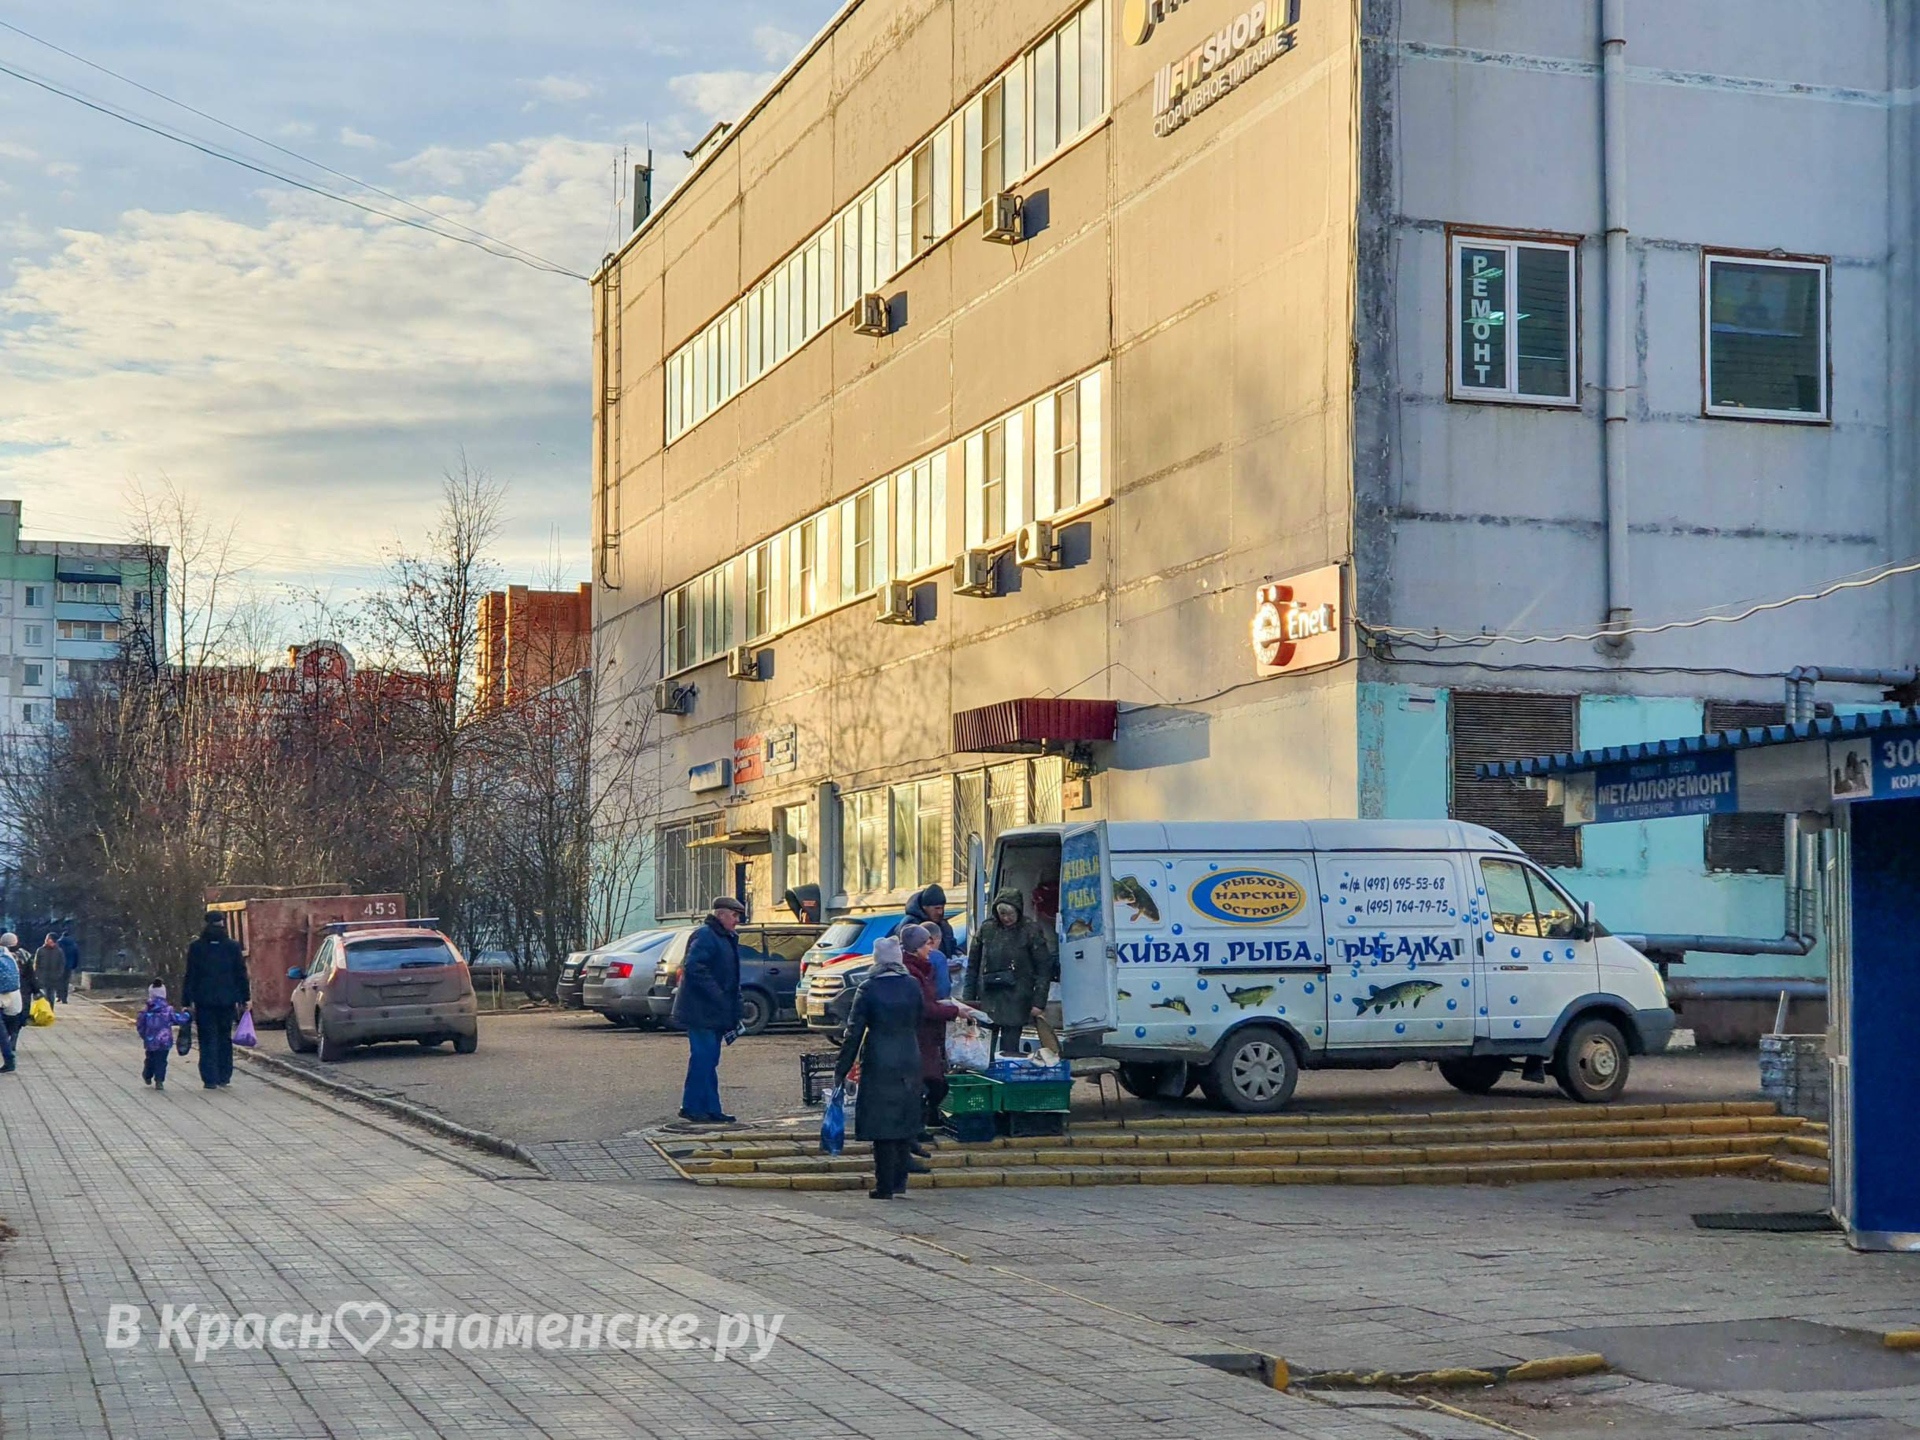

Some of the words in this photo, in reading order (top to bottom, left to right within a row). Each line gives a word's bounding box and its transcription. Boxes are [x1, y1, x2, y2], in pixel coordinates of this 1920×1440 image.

[1169, 1, 1266, 100] FITSHOP
[1153, 79, 1228, 138] СПОРТИВНОЕ
[1229, 30, 1287, 87] ПИТАНИЕ
[1471, 255, 1491, 384] РЕМОНТ
[1598, 771, 1732, 805] МЕТАЛЛОРЕМОНТ
[1891, 774, 1920, 790] КОР
[1220, 876, 1286, 890] РЫБХОЗ
[1364, 876, 1390, 892] (498)
[1393, 877, 1446, 891] 695-53-68
[1068, 886, 1097, 910] РЫБА
[1214, 891, 1298, 900] НАРСКИЕ
[364, 902, 397, 916] 453
[1221, 902, 1290, 916] ОСТРОВА
[1366, 899, 1393, 916] (495)
[1395, 899, 1448, 913] 764-79-75
[1227, 940, 1312, 962] РЫБА
[1344, 935, 1455, 963] РЫБАЛКА
